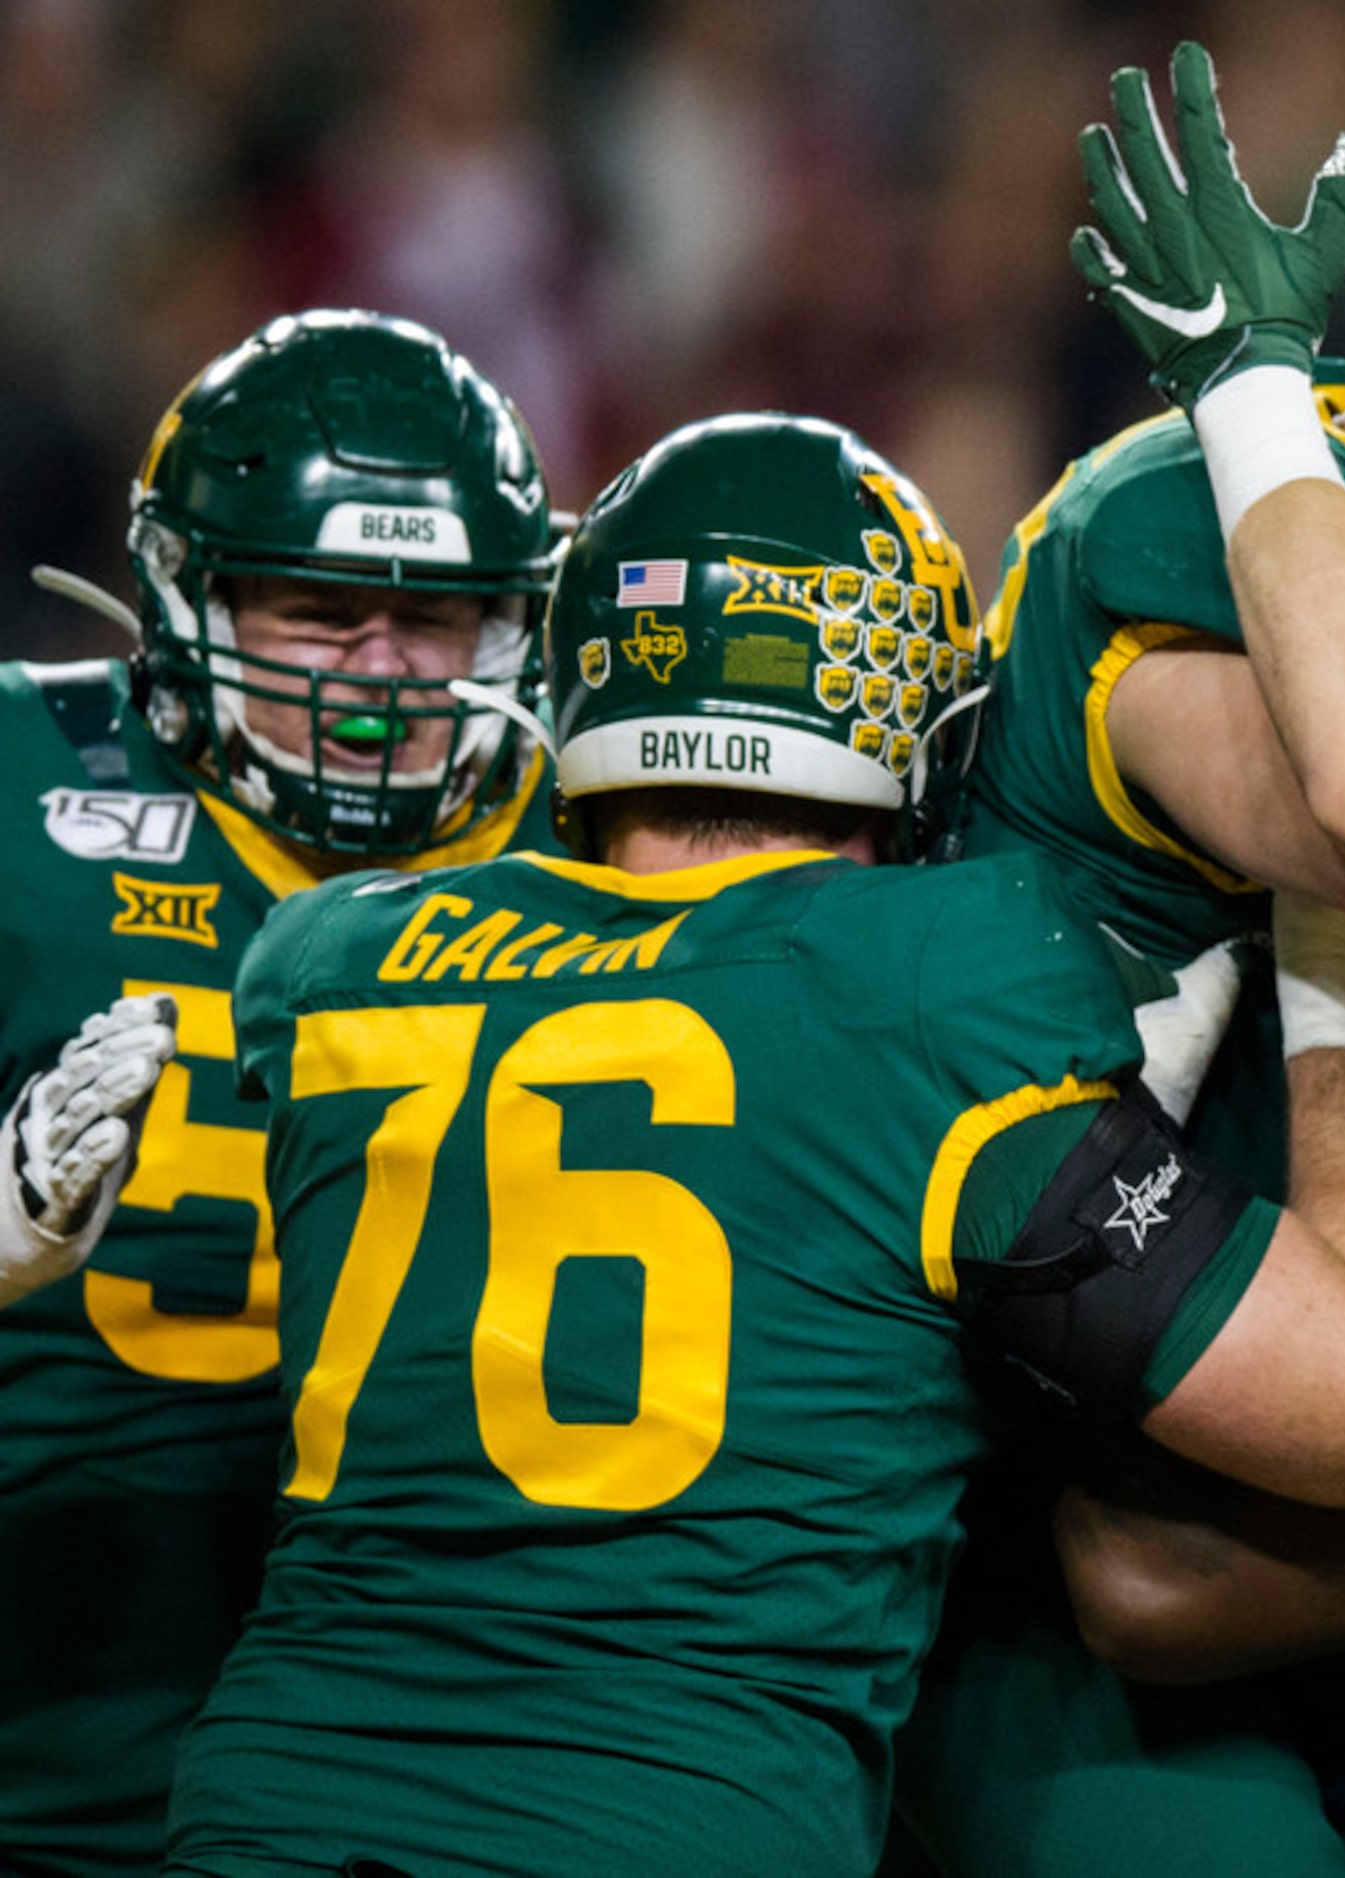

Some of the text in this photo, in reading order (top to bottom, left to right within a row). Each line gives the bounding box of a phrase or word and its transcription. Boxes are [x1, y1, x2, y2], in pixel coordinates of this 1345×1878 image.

[361, 514, 436, 545] BEARS
[637, 635, 680, 656] 832
[641, 730, 771, 776] BAYLOR
[117, 878, 216, 942] XII
[377, 893, 694, 982] GALVIN
[283, 998, 736, 1512] 76
